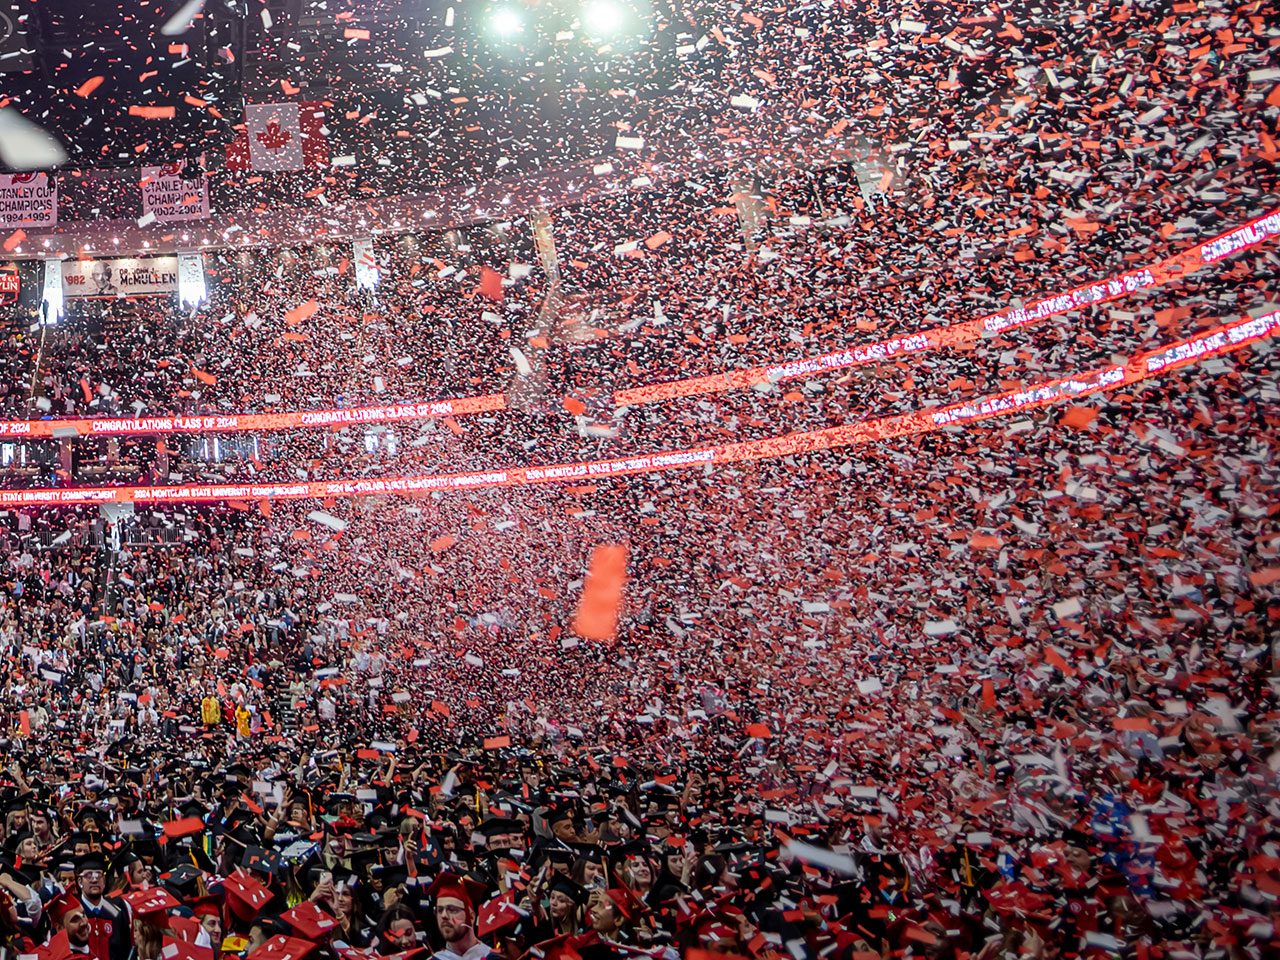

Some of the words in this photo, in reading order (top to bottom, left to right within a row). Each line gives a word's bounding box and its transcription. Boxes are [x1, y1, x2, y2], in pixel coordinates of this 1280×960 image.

[36, 187, 55, 198] CUP
[10, 422, 31, 433] 2024
[92, 419, 172, 432] CONGRATULATIONS
[174, 418, 202, 429] CLASS
[203, 417, 215, 428] OF
[2, 492, 22, 502] STATE
[134, 490, 151, 499] 2024
[190, 488, 212, 498] STATE
[212, 486, 251, 498] UNIVERSITY
